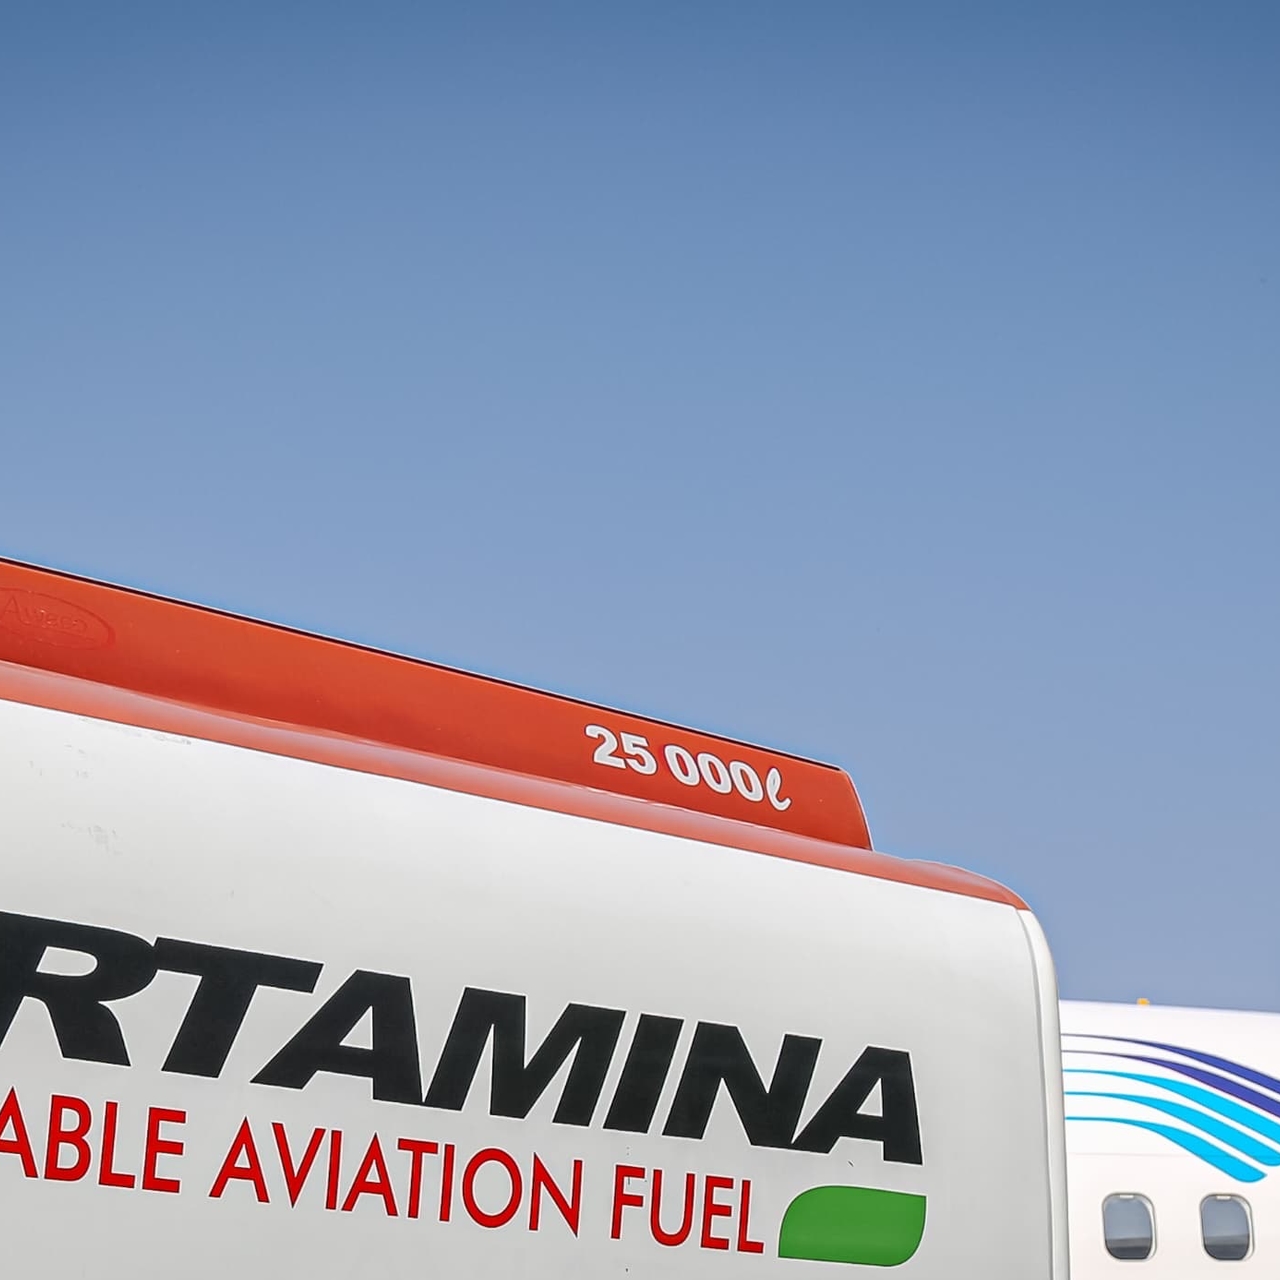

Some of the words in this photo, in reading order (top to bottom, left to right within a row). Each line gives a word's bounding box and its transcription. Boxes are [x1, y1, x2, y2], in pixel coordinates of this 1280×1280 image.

[584, 724, 658, 775] 25
[209, 1118, 583, 1235] AVIATION
[611, 1164, 764, 1254] FUEL
